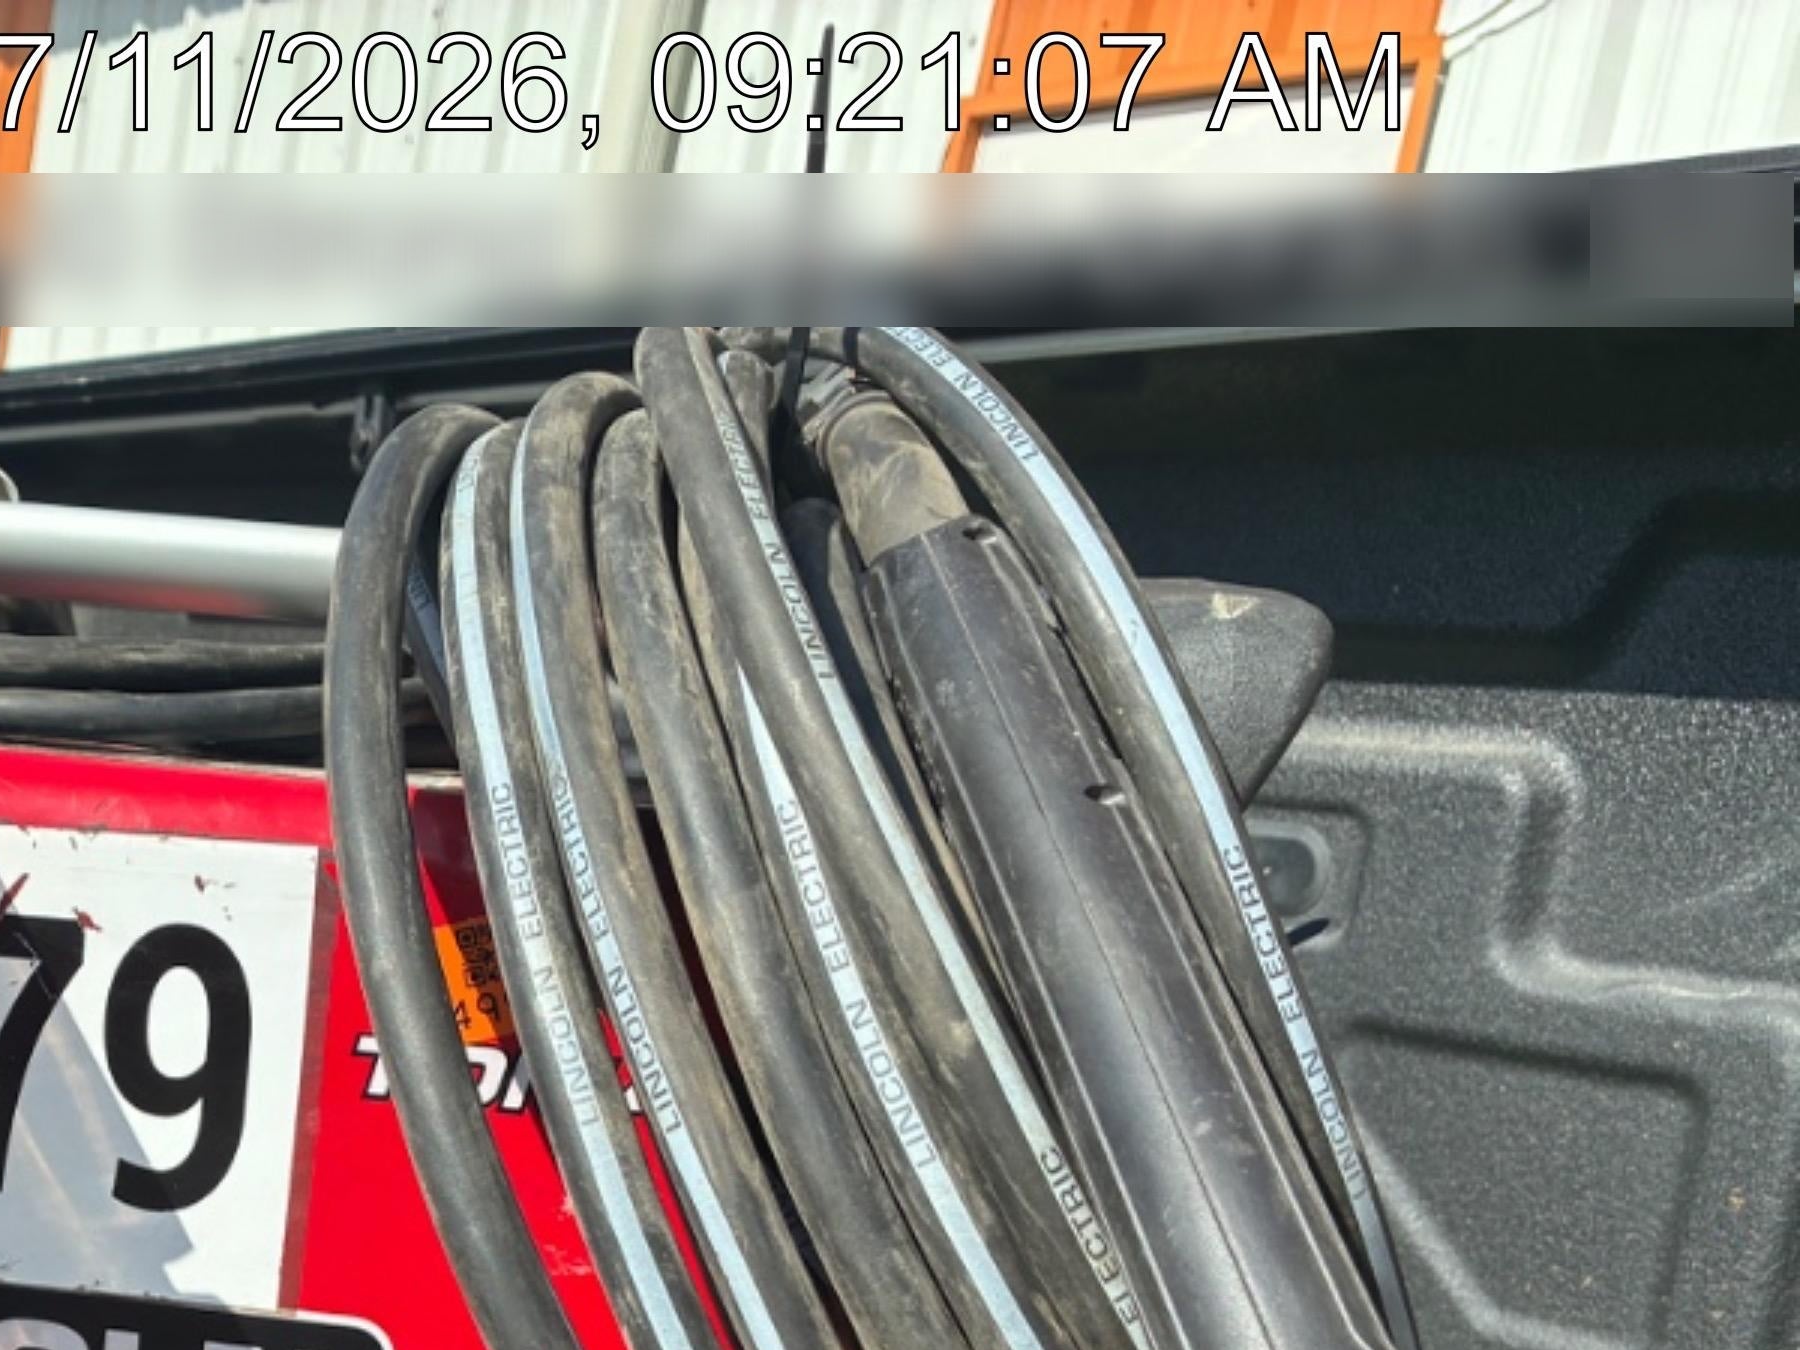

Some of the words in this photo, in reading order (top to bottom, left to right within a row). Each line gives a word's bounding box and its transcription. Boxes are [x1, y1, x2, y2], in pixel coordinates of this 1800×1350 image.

[955, 374, 1038, 461] LINCOLN
[765, 542, 835, 680] LINCOLN
[491, 782, 544, 941] ELECTRIC
[552, 776, 609, 941] ELECTRIC
[776, 800, 850, 973] ELECTRIC
[1223, 845, 1303, 1024] ELECTRIC
[534, 965, 599, 1128] LINCOLN
[608, 965, 682, 1134] LINCOLN
[845, 998, 938, 1170] LINCOLN
[1300, 1050, 1367, 1199] LINCOLN
